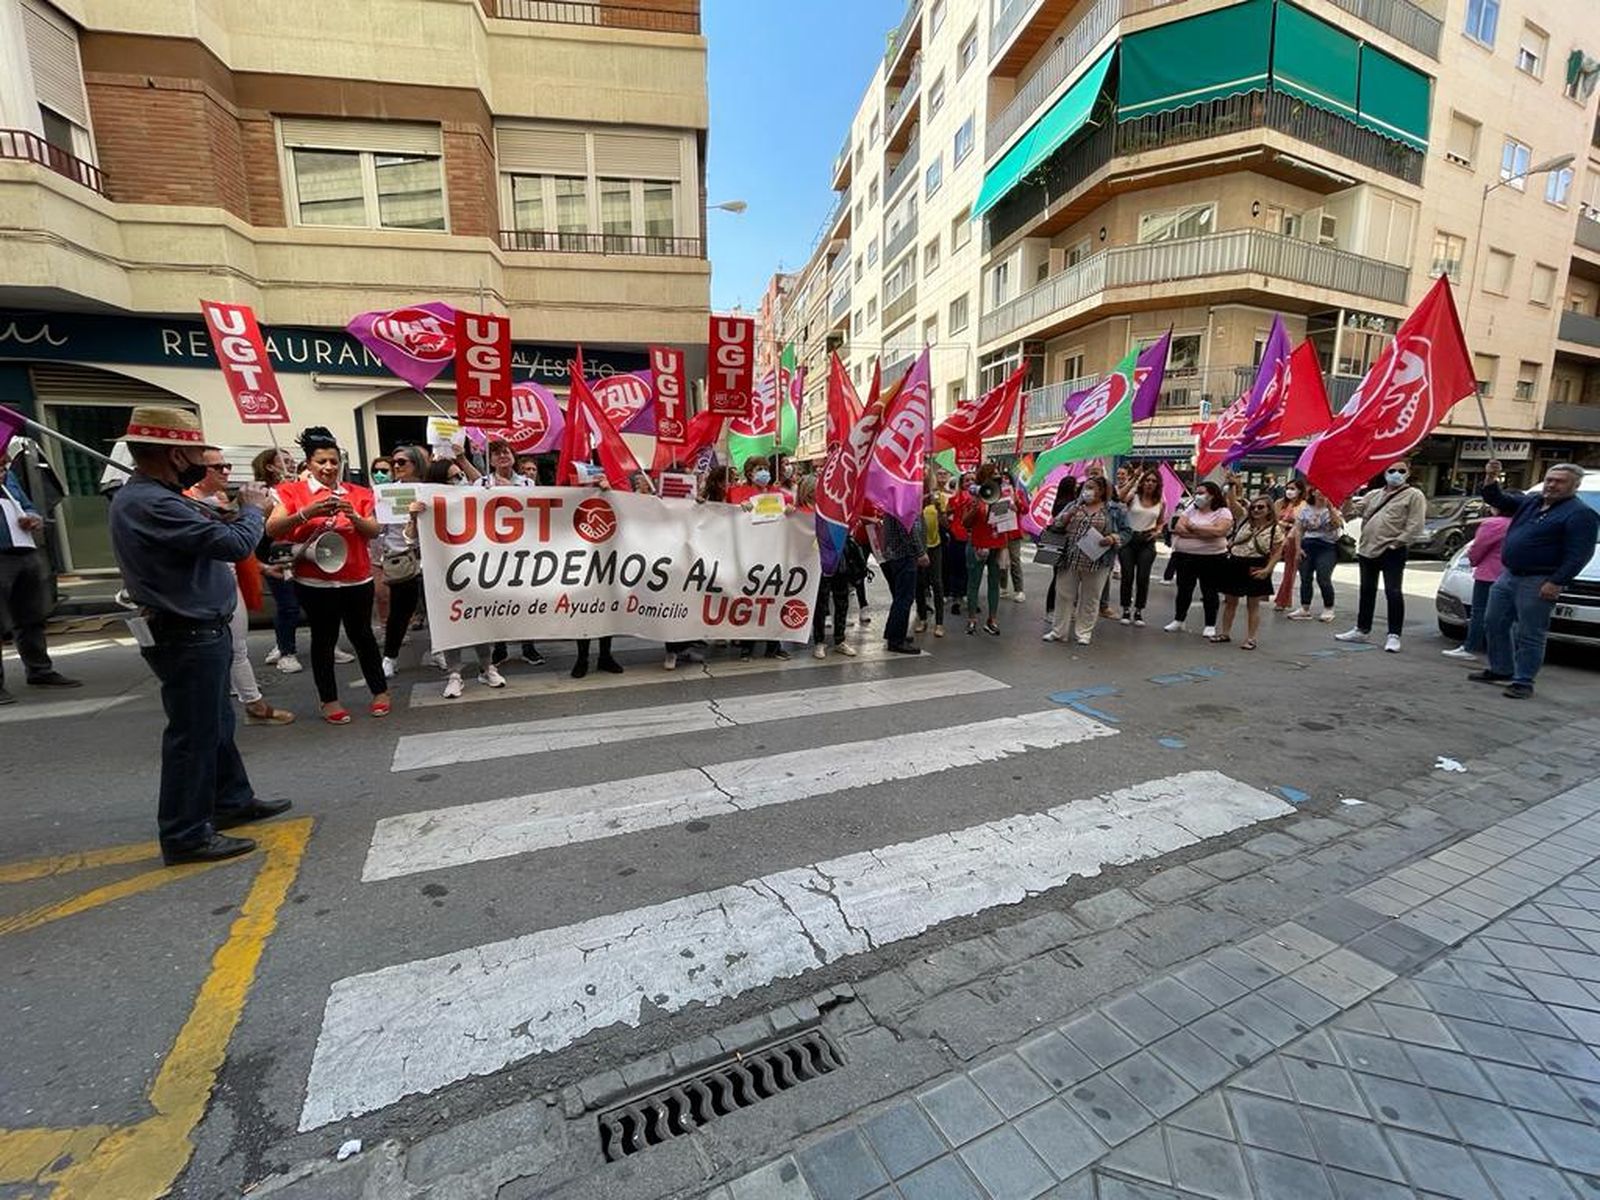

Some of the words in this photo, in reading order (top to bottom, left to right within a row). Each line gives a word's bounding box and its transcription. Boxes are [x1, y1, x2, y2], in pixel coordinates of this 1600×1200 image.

[162, 329, 383, 368] REAURAN
[208, 307, 262, 391] UGT
[466, 318, 501, 396] UGT
[512, 351, 530, 364] AL
[717, 320, 746, 390] UGT
[654, 350, 680, 419] UGT
[433, 496, 563, 545] UGT
[445, 550, 672, 592] CUIDEMOS
[683, 557, 723, 593] AL
[742, 563, 808, 597] SAD
[450, 598, 520, 622] Servicio
[528, 600, 548, 615] de
[555, 593, 606, 618] Ayuda
[611, 601, 619, 612] a
[626, 595, 689, 619] Domicilio
[702, 594, 776, 627] UGT
